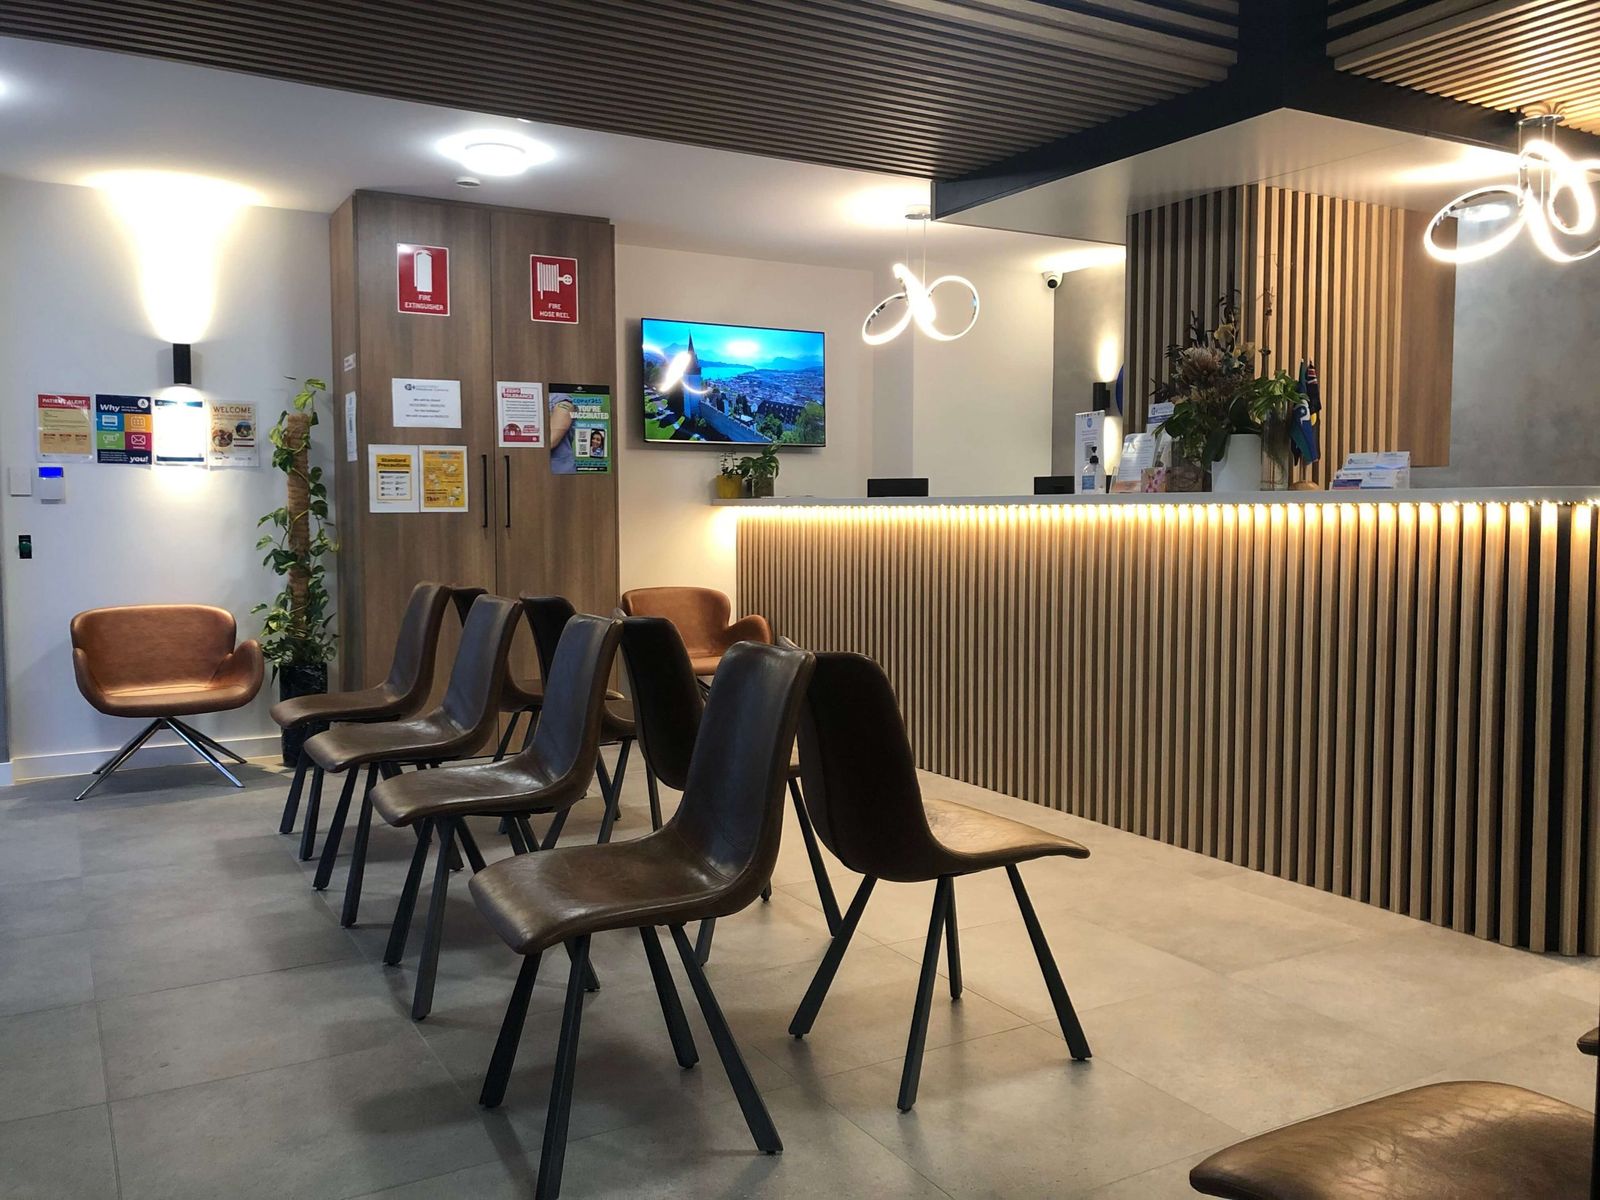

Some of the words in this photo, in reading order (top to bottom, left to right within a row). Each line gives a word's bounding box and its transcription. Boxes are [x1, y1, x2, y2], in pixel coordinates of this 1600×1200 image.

[404, 302, 444, 310] EXTINGUISHER
[100, 404, 120, 412] Why
[213, 406, 252, 414] WELCOME
